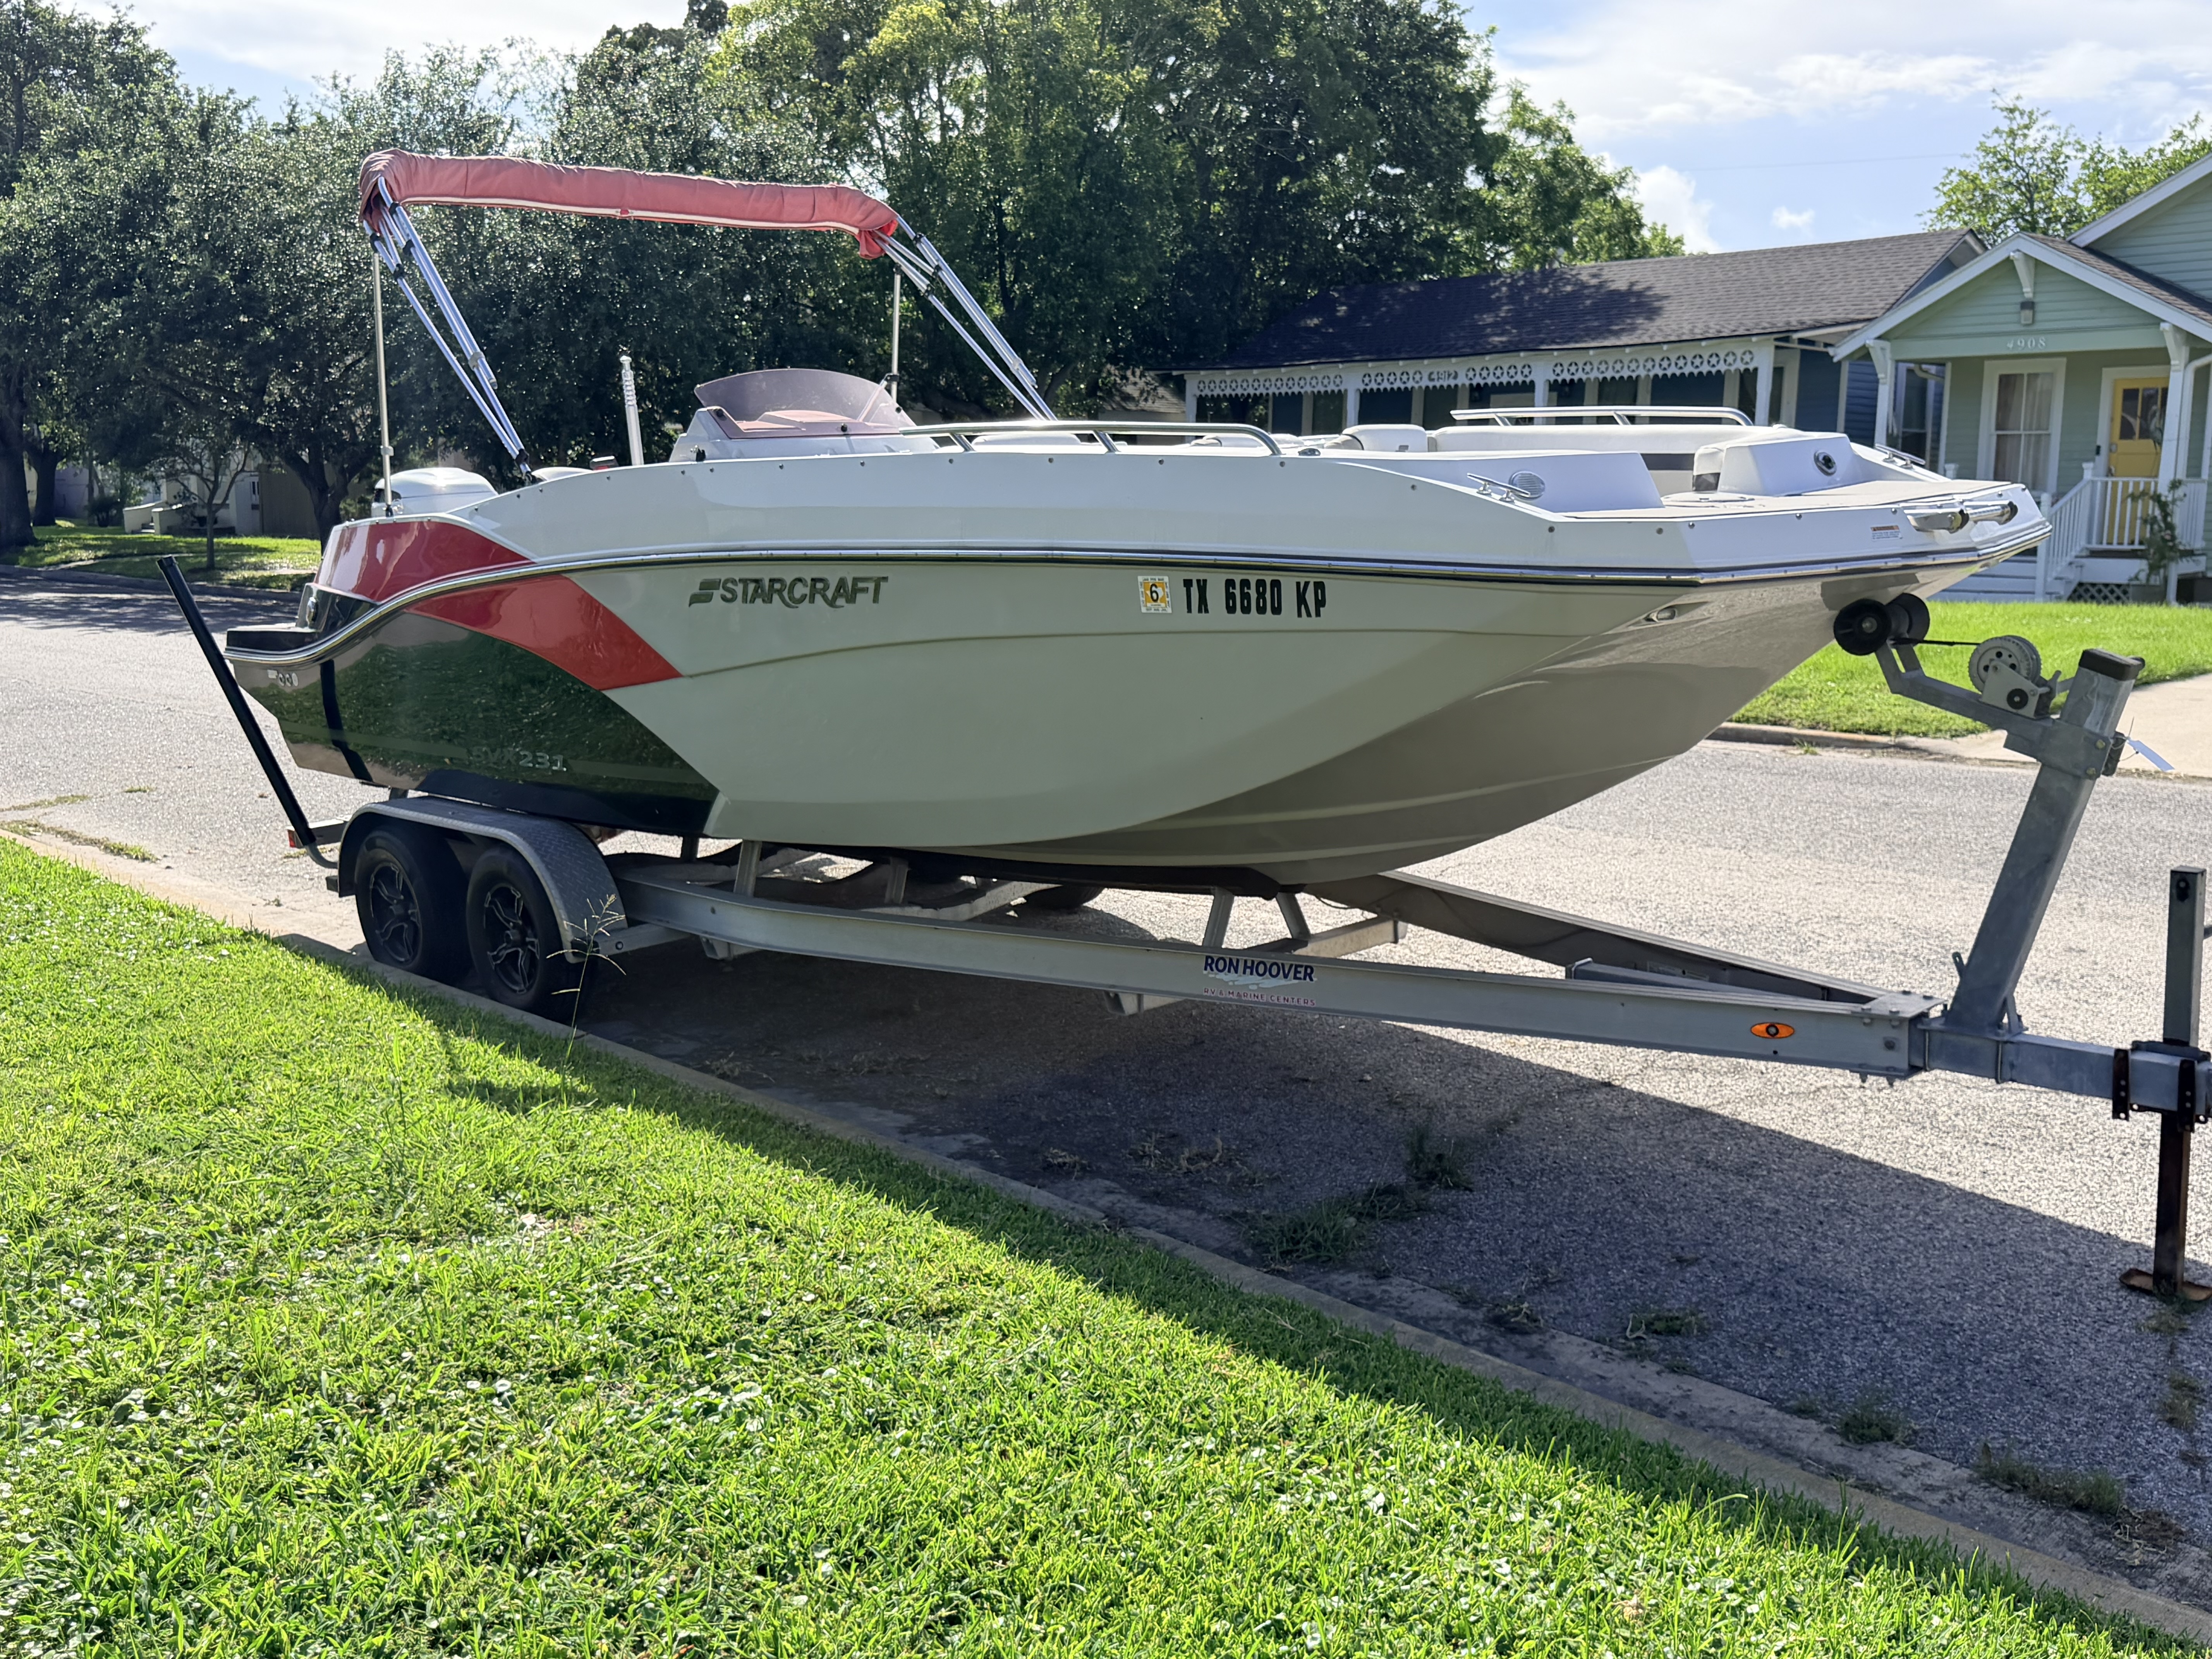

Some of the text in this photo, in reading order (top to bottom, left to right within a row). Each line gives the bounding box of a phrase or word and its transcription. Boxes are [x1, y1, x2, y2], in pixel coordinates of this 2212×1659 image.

[2006, 336, 2045, 350] 4908
[720, 576, 888, 608] STARCRAFT
[1150, 583, 1159, 603] 6
[1183, 579, 1209, 614] TX
[1224, 579, 1282, 615] 6680
[1296, 581, 1326, 618] KP
[1204, 955, 1314, 982] RON HOOVER
[1228, 990, 1266, 1001] MARINE
[1270, 995, 1316, 1006] CENTERS
